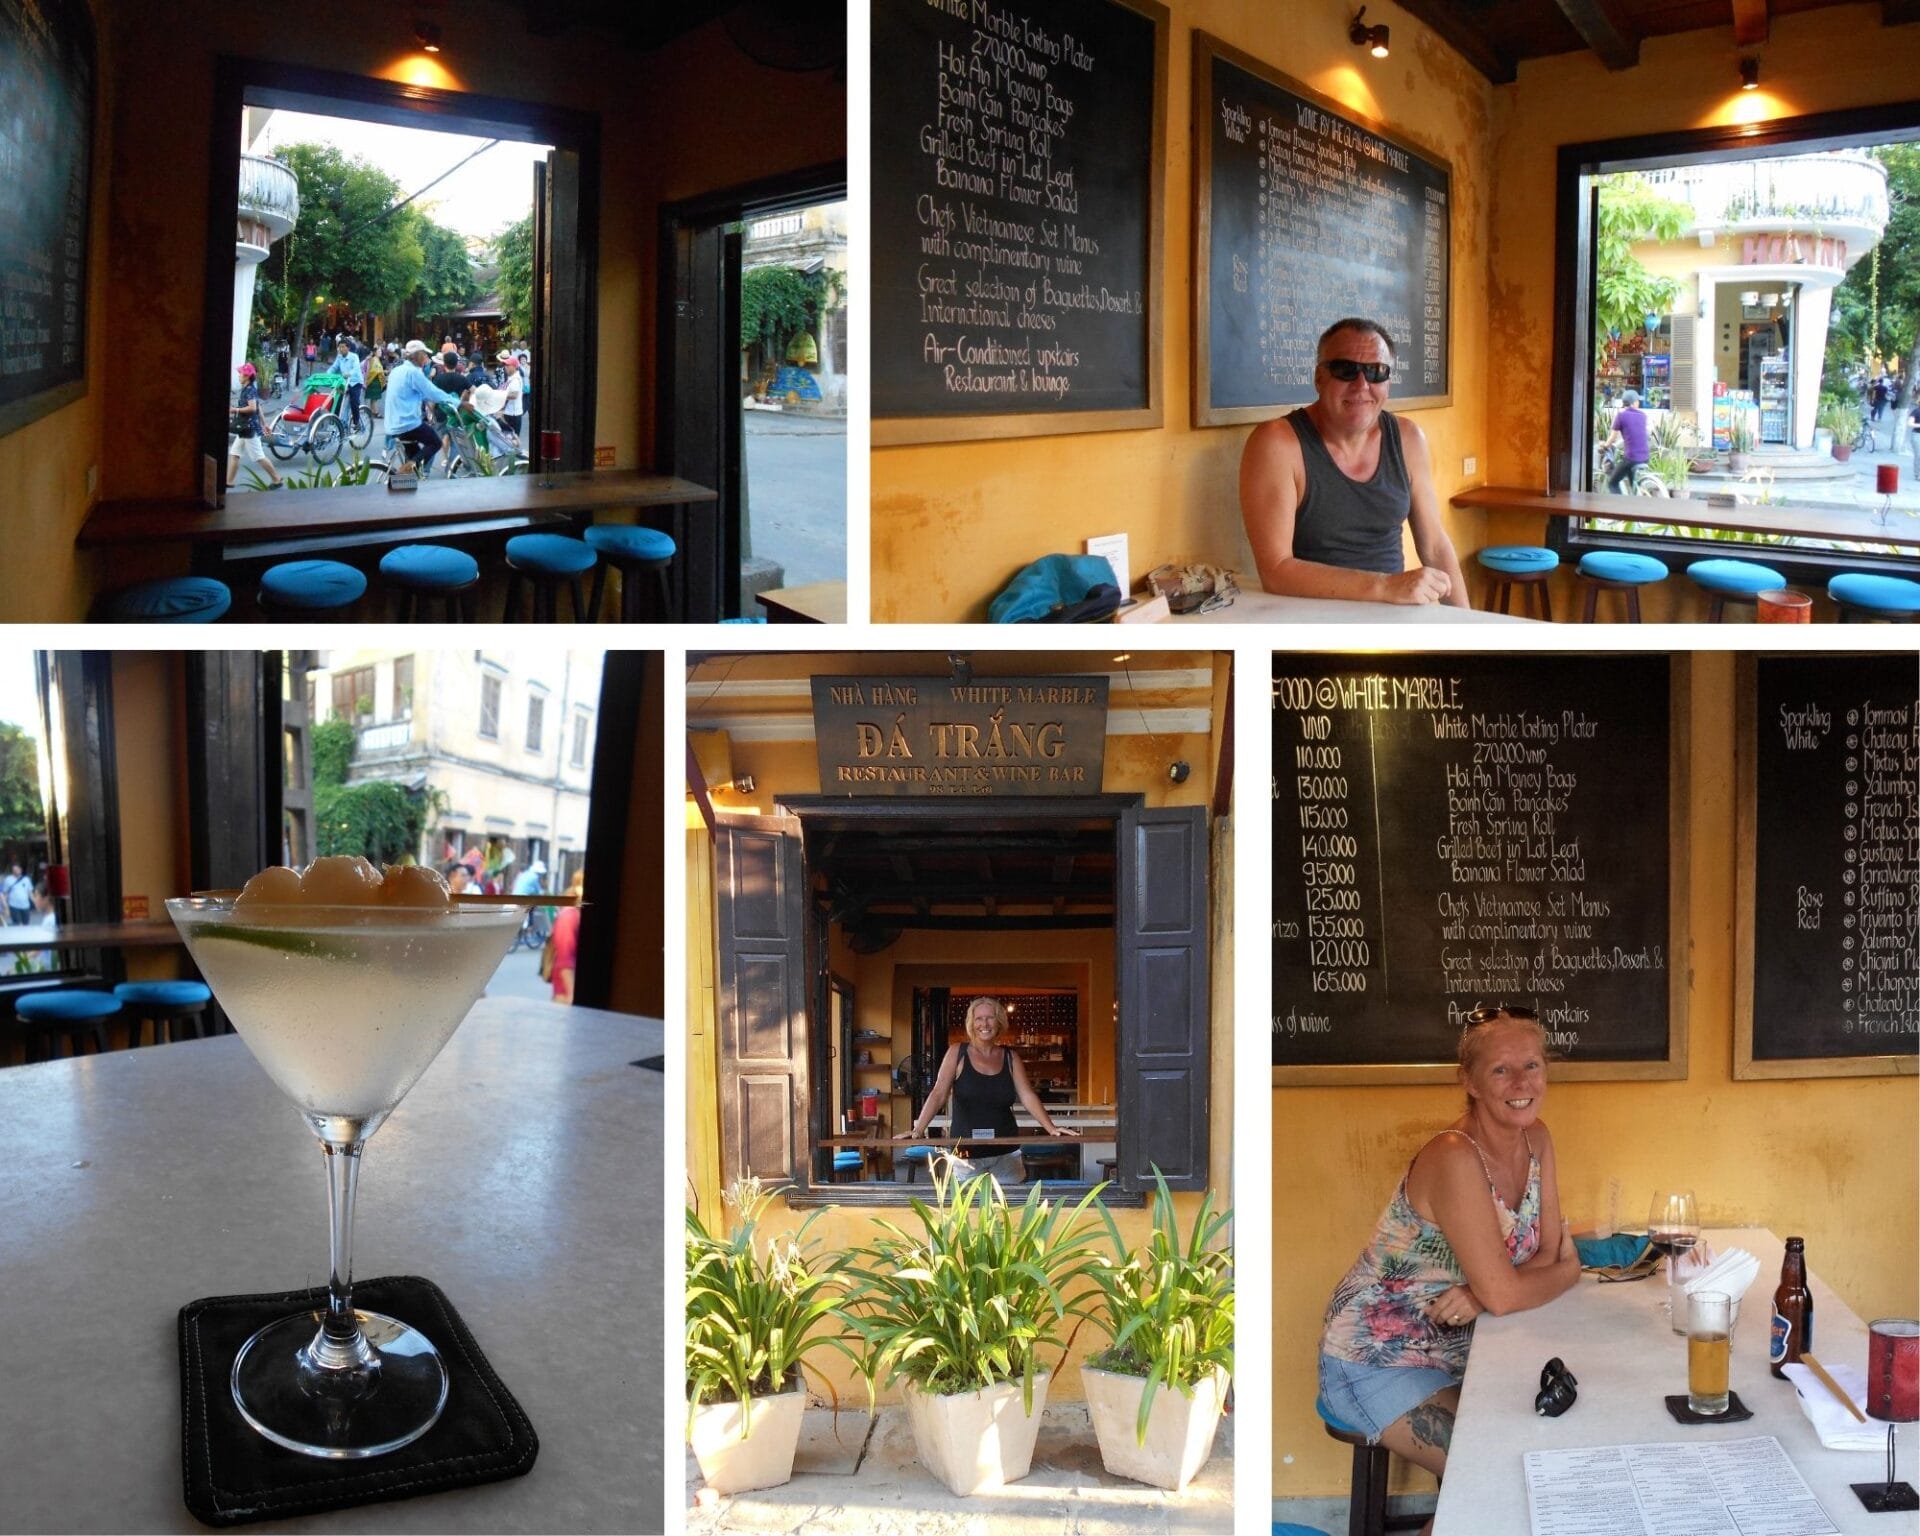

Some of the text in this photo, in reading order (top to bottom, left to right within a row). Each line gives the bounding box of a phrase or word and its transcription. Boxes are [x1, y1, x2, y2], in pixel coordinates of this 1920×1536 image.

[972, 0, 1021, 43] Marble
[1022, 18, 1060, 64] Tasting
[1064, 34, 1095, 72] Plater
[939, 40, 1074, 123] Hoi An Money Bags
[938, 102, 973, 133] Fresh
[981, 115, 1024, 158] Spring
[1012, 98, 1065, 138] Pancakes
[920, 125, 964, 162] Grilled
[967, 138, 996, 171] Beef
[1002, 153, 1016, 175] in
[1047, 159, 1074, 192] Leaf
[937, 158, 1078, 215] Banana Flower Salad
[962, 200, 1034, 243] Vietnamese
[1040, 219, 1058, 249] Set
[1064, 224, 1099, 256] Menus
[920, 230, 1082, 275] with complimentary wine
[917, 262, 957, 296] Great
[966, 270, 1020, 302] selection
[1025, 279, 1036, 310] of
[920, 293, 1056, 330] International cheeses
[1037, 341, 1079, 375] upstairs
[944, 364, 1017, 394] Restaurant
[1031, 369, 1070, 400] lounge
[829, 682, 919, 705] NHÀ HÀNG
[951, 686, 1096, 704] WHITE MARBLE
[1271, 676, 1464, 711] FOOD @ WHITE MARBLE
[1780, 703, 1832, 735] Sparkling
[1863, 699, 1908, 725] Tommasi
[856, 705, 1066, 760] ĐÁ TRẮNG
[1301, 715, 1331, 740] VND
[1431, 710, 1599, 746] White Marble Tasting Plater
[1785, 728, 1819, 750] White
[1862, 726, 1908, 749] Chateau
[1296, 746, 1341, 769] 110.000
[837, 766, 1086, 782] RESTAURANT & WINE BAR
[1446, 763, 1577, 797] Hoi An Money Bags
[1864, 770, 1916, 795] Yalumba
[1297, 776, 1347, 800] 130.000
[1513, 788, 1569, 814] Pancakes
[1864, 795, 1902, 818] French
[1299, 805, 1348, 829] 115.000
[1449, 812, 1480, 836] Fresh
[1486, 812, 1528, 843] Spring
[1861, 817, 1899, 841] Matua
[1302, 835, 1357, 858] 140.000
[1437, 835, 1580, 861] Grilled Beef in Lot Leaf
[1859, 840, 1904, 862] Gustave
[1302, 861, 1355, 886] 95.000
[1451, 858, 1585, 882] Banana Flower Salad
[1306, 888, 1361, 912] 125.000
[1474, 892, 1541, 917] Vietnamese
[1547, 891, 1567, 917] Set
[1571, 891, 1611, 917] Menus
[1797, 885, 1823, 909] Rose
[1860, 883, 1905, 912] Ruffino
[1308, 914, 1364, 938] 155.000
[1797, 908, 1820, 930] Red
[1858, 906, 1903, 928] Trivento
[1442, 918, 1592, 947] with complimentary wine
[1859, 927, 1906, 950] Yalumba
[1310, 939, 1370, 967] 120.000
[1441, 946, 1472, 970] Great
[1480, 947, 1528, 971] selection
[1533, 948, 1545, 976] of
[1653, 945, 1665, 970] &
[1859, 950, 1899, 971] Chianti
[1313, 971, 1366, 992] 165.000
[1444, 970, 1565, 994] International cheeses
[1857, 992, 1902, 1012] Chateau
[1301, 1013, 1332, 1033] wine
[1546, 1001, 1590, 1031] upstairs
[1858, 1012, 1899, 1034] French
[1544, 1031, 1579, 1052] ounge
